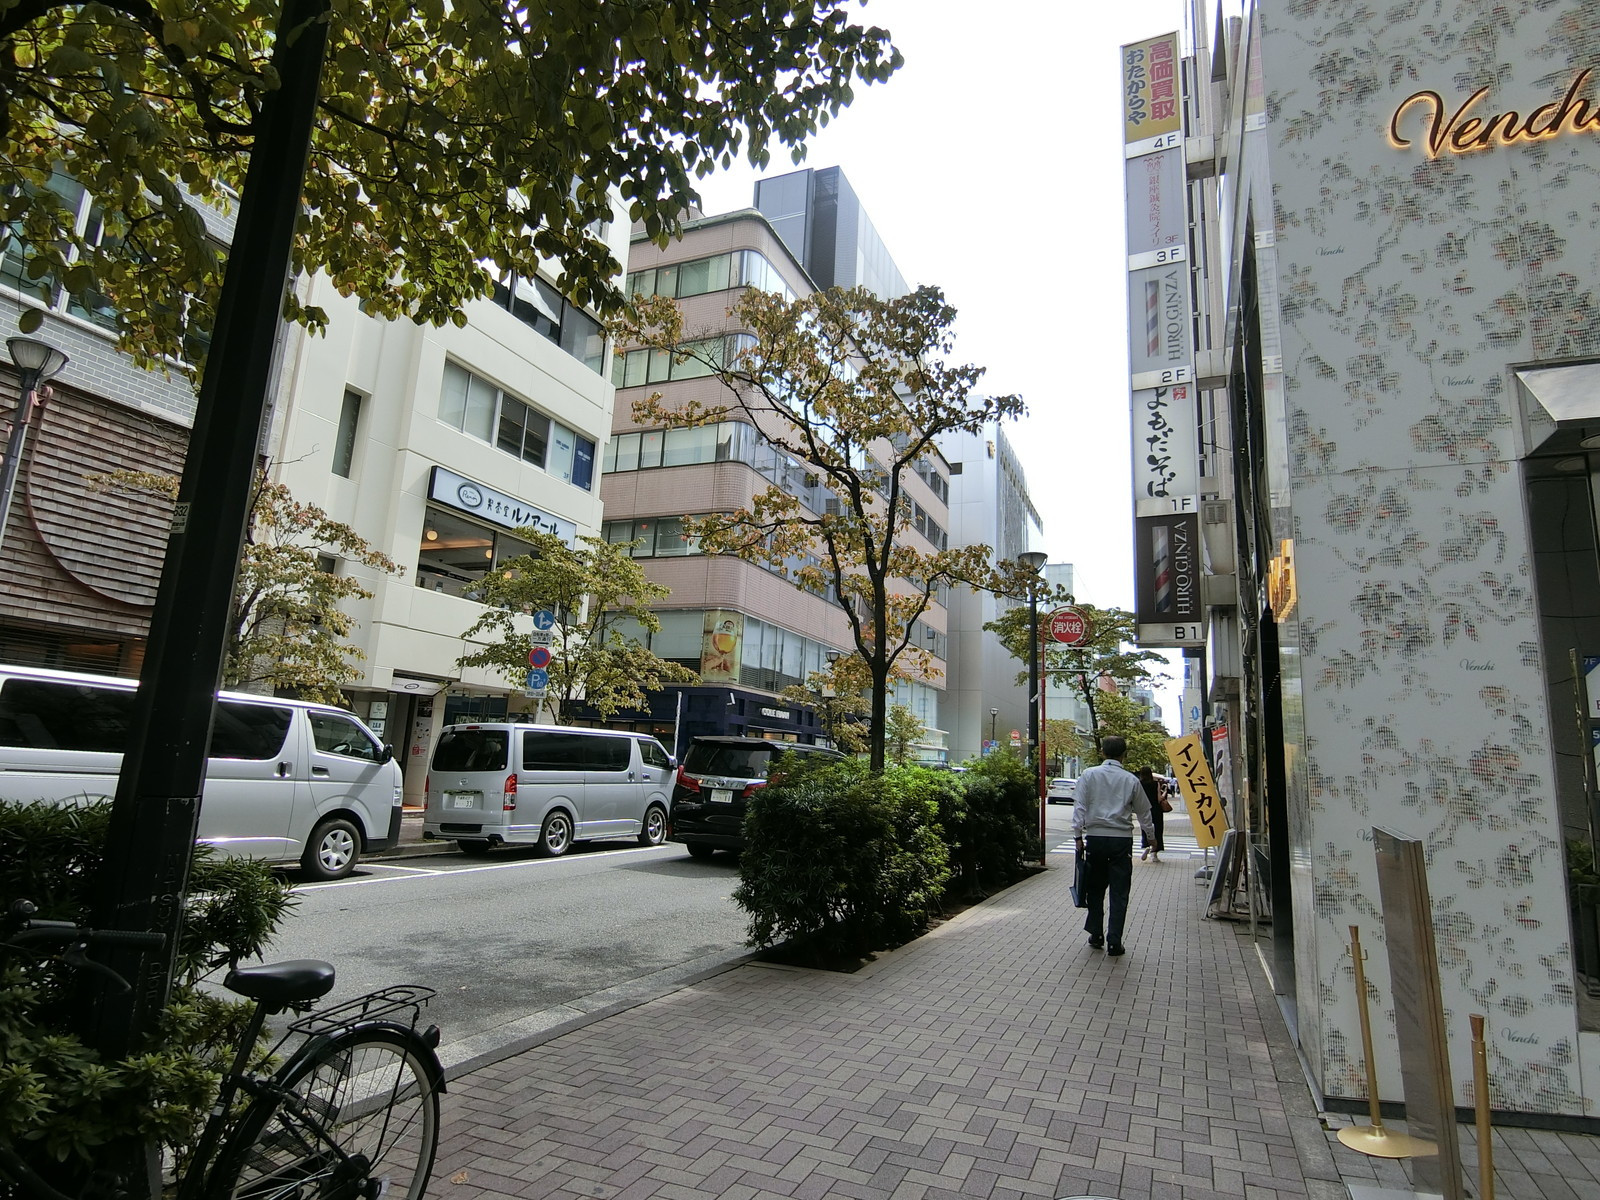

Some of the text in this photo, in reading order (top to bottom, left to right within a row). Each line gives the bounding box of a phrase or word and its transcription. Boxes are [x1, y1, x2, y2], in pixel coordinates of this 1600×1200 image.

[1126, 49, 1147, 126] おたからや
[1148, 40, 1176, 121] 高価買取
[1154, 135, 1176, 149] 4F
[1165, 234, 1178, 244] 3F
[1156, 248, 1180, 262] 3F
[1315, 245, 1345, 257] Venchi
[1163, 269, 1183, 361] HIRO GINZA
[1161, 369, 1185, 383] 2F
[1441, 375, 1475, 389] Venchi
[1171, 498, 1191, 511] 1F
[511, 507, 560, 535] ルノアール
[1174, 520, 1193, 615] HIRO GINZA
[1053, 621, 1082, 634] 消火栓
[1175, 626, 1197, 640] B1
[1458, 658, 1496, 672] Venchi
[1584, 657, 1597, 666] 7F
[531, 674, 540, 687] P
[1177, 743, 1217, 840] インドカレー
[1501, 1027, 1540, 1045] Venchi
